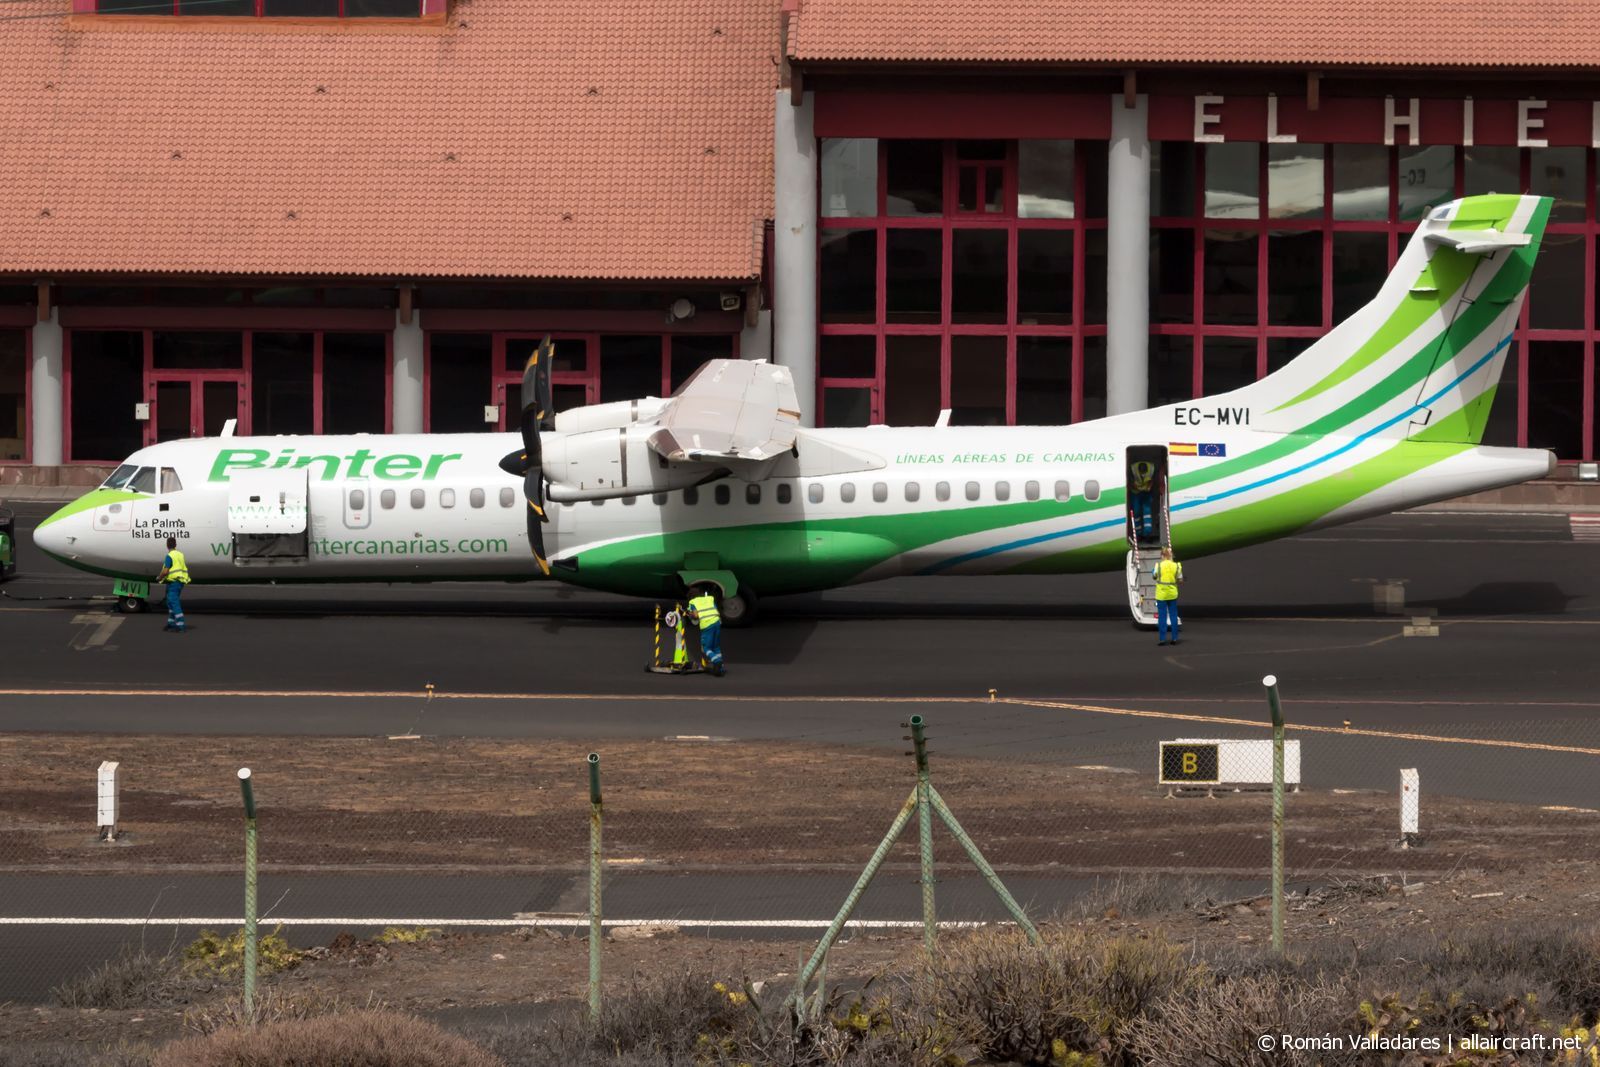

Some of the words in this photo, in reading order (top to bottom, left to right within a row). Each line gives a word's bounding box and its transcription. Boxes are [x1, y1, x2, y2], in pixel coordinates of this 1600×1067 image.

[1194, 95, 1297, 143] EL
[1384, 97, 1600, 148] HIE
[1174, 407, 1249, 426] EC-MVI
[207, 448, 463, 482] Binter
[895, 452, 945, 464] LÍNEAS
[952, 452, 1007, 464] AÉREAS
[1015, 453, 1034, 463] DE
[1042, 452, 1115, 463] CANARIAS
[135, 518, 148, 528] La
[152, 518, 186, 528] Palma
[132, 529, 151, 539] Isla
[154, 529, 190, 539] Bonita
[120, 582, 142, 594] MVI
[1182, 752, 1198, 774] B
